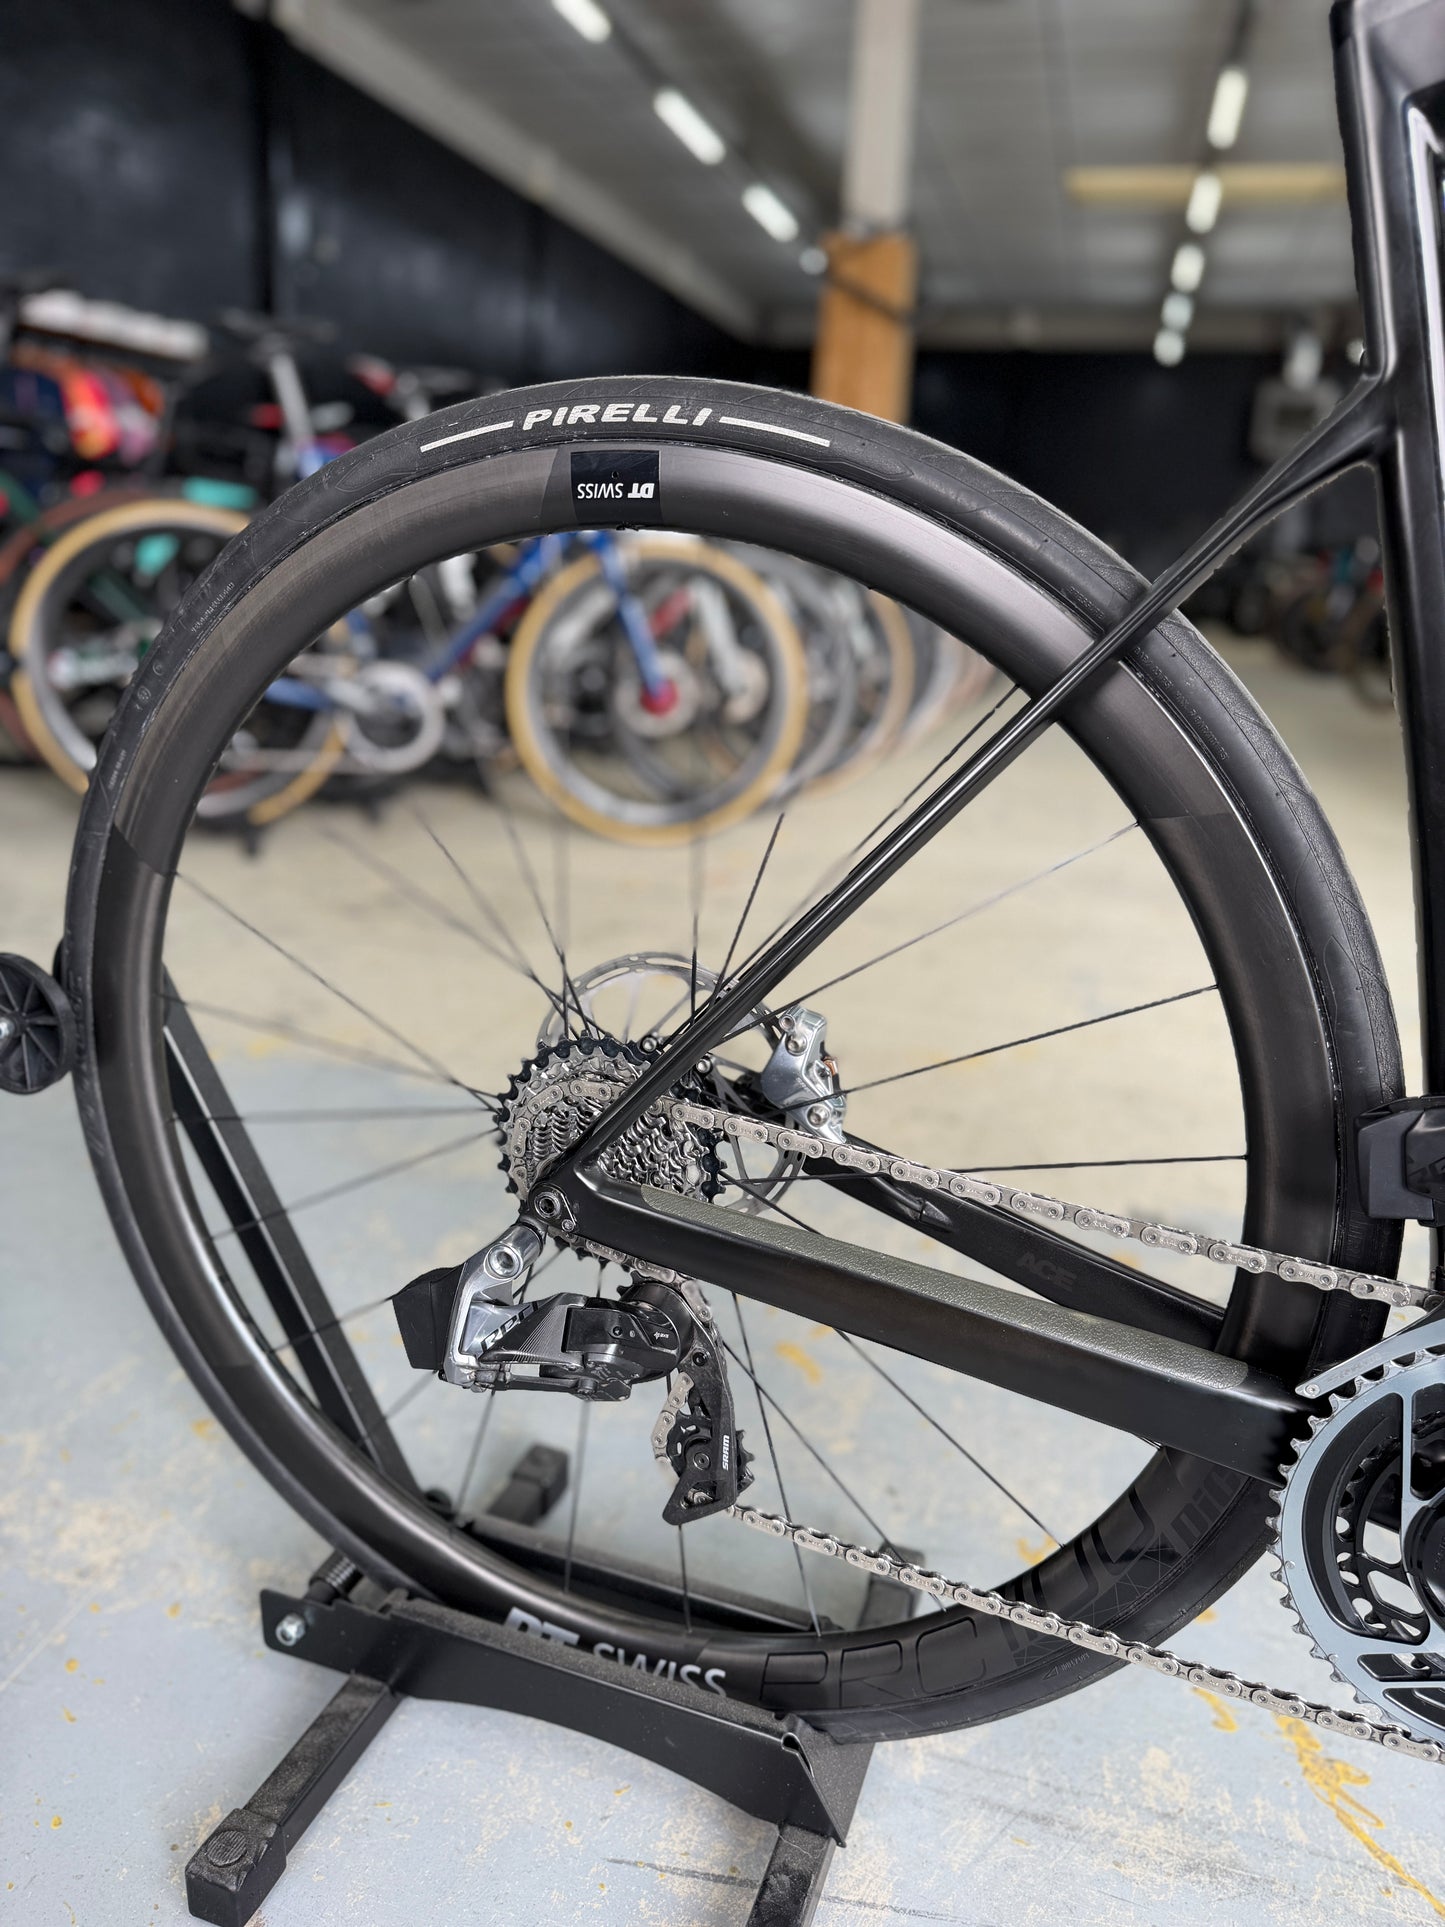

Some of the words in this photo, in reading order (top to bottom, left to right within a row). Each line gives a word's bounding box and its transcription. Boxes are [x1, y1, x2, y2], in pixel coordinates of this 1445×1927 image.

[522, 403, 713, 431] PIRELLI
[577, 482, 624, 499] SWISS
[627, 482, 655, 499] DT
[1016, 1251, 1078, 1292] ACE
[722, 1434, 730, 1471] SRAM
